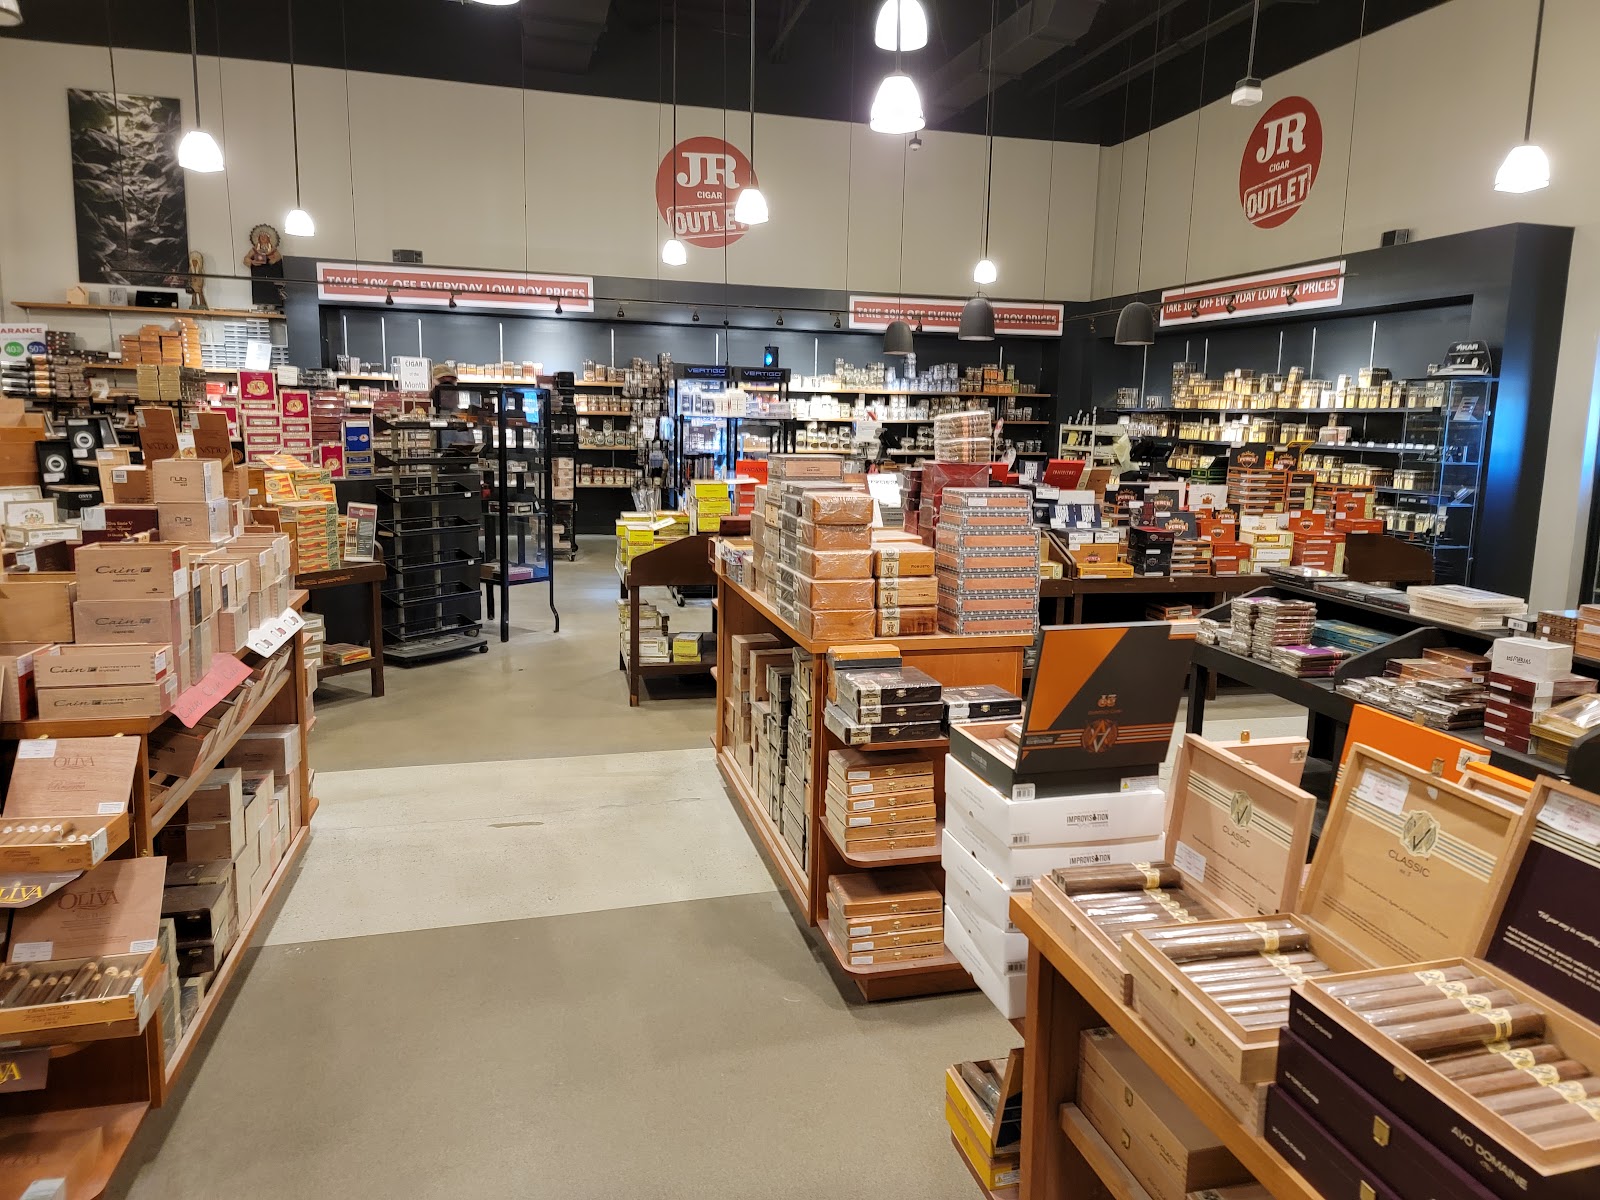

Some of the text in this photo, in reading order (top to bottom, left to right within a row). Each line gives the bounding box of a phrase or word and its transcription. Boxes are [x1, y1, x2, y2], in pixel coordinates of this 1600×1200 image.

[1256, 112, 1306, 163] JR
[677, 152, 740, 189] JR
[1269, 160, 1290, 173] CIGAR
[697, 191, 723, 199] CIGAR
[1247, 173, 1308, 219] OUTLET
[675, 208, 742, 234] OUTLE
[1215, 291, 1256, 308] EVEYDAY
[1258, 287, 1279, 302] LOW
[1281, 284, 1300, 298] BX
[1302, 277, 1338, 295] PRICES
[857, 307, 881, 319] TAKE
[1025, 314, 1057, 326] PRICES
[404, 380, 426, 389] Month
[95, 566, 138, 574] Cain
[95, 618, 137, 626] Cain
[53, 755, 96, 769] OLIVA
[1222, 825, 1251, 849] CLASSIC
[1388, 849, 1431, 878] CLASSIC
[58, 890, 120, 910] OLIVA
[1207, 1035, 1234, 1063] CLASSIC
[1223, 1083, 1249, 1112] CLASSIC
[1160, 1144, 1181, 1171] CLASSIC
[1451, 1126, 1528, 1191] AVO DOMAINE
